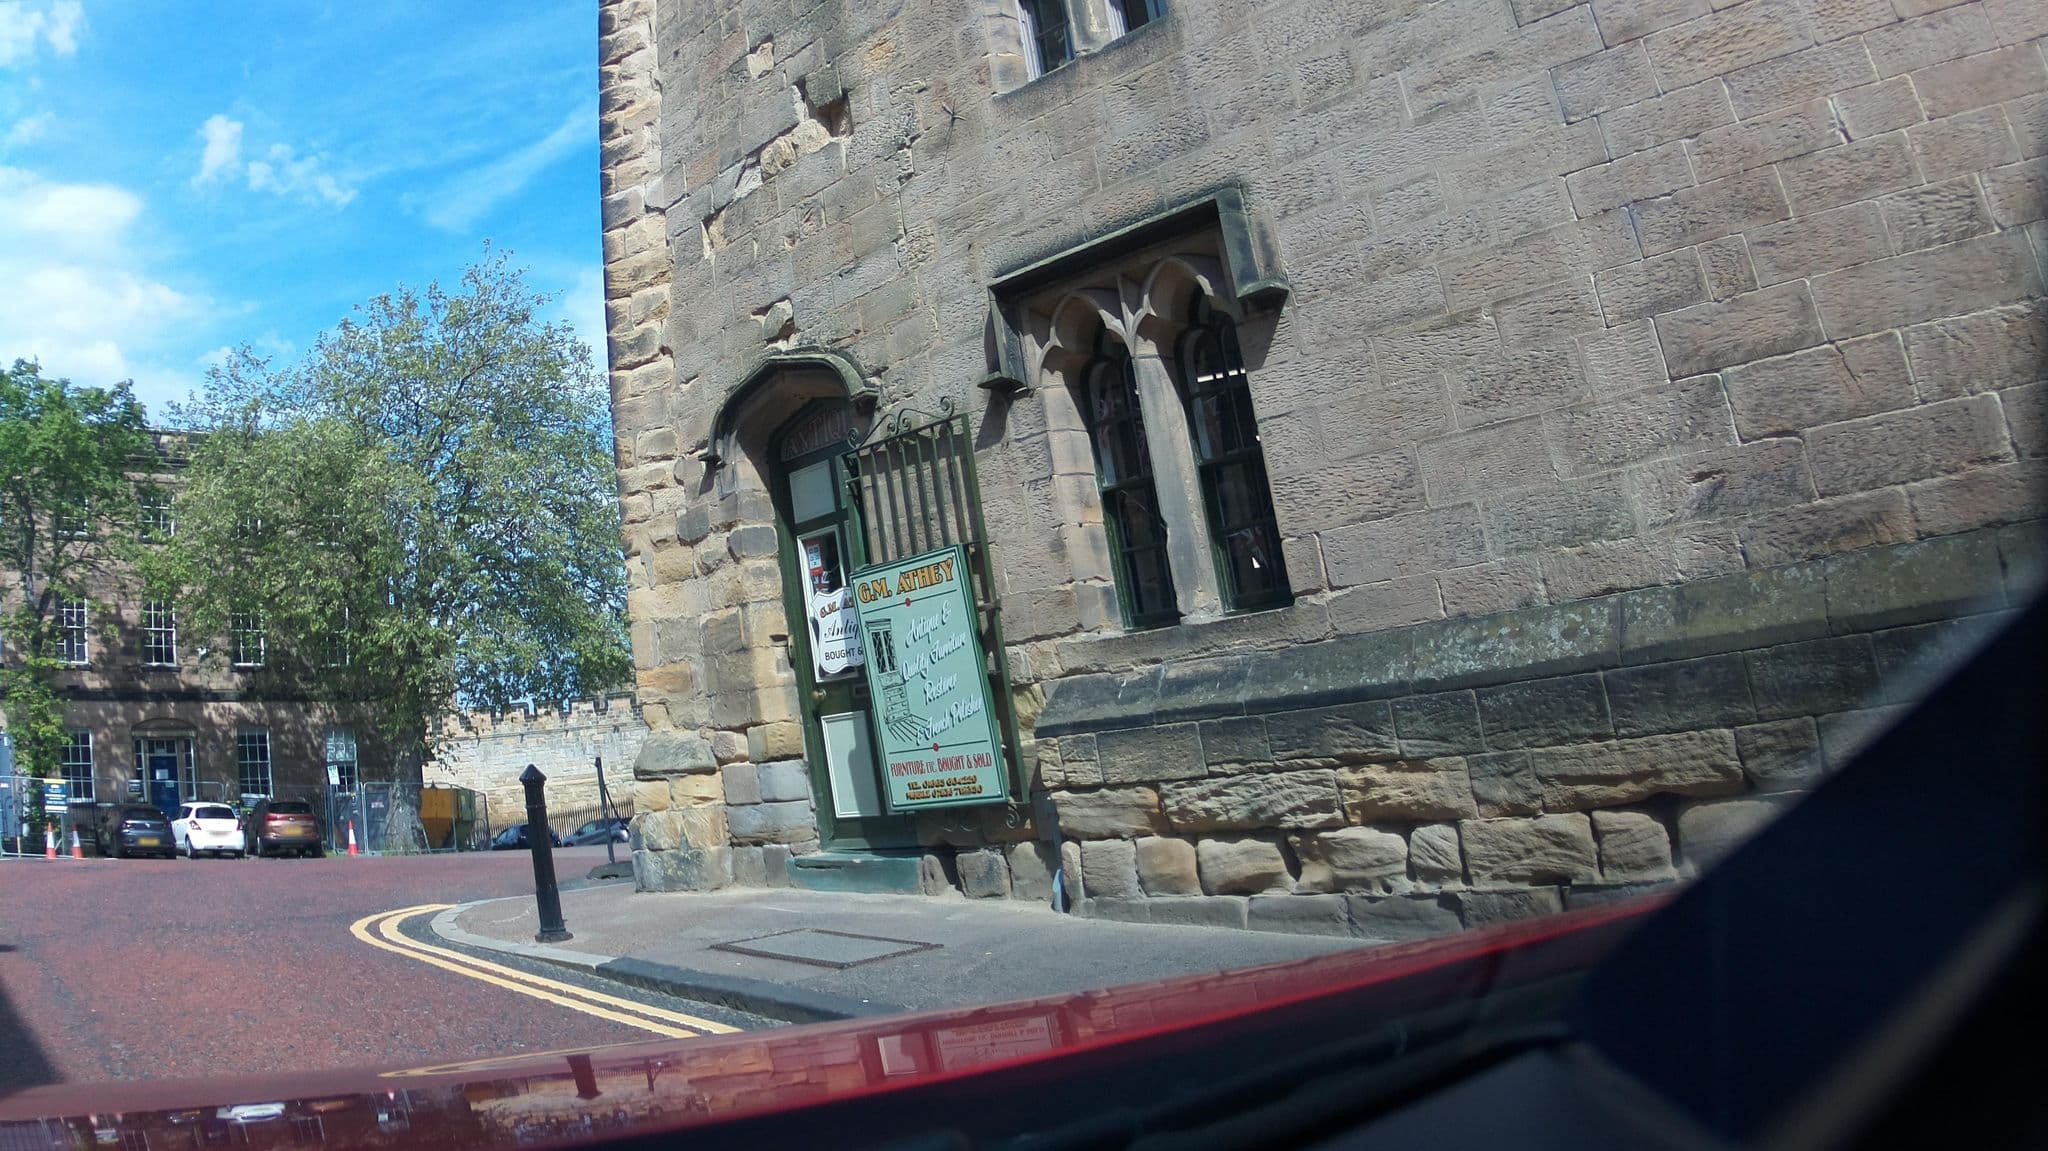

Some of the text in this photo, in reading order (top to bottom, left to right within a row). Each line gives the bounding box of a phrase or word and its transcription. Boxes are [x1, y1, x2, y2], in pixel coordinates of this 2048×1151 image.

[858, 557, 954, 603] G.M. ATHEY
[824, 619, 859, 639] Antiq
[905, 600, 951, 648] Antique &
[825, 648, 855, 660] BOUGHT
[902, 632, 966, 682] Quality Furniture
[924, 708, 949, 740] French
[890, 760, 925, 776] FURNITURE
[937, 755, 965, 772] BOUGHT
[966, 755, 973, 769] &
[973, 753, 992, 769] SOLD
